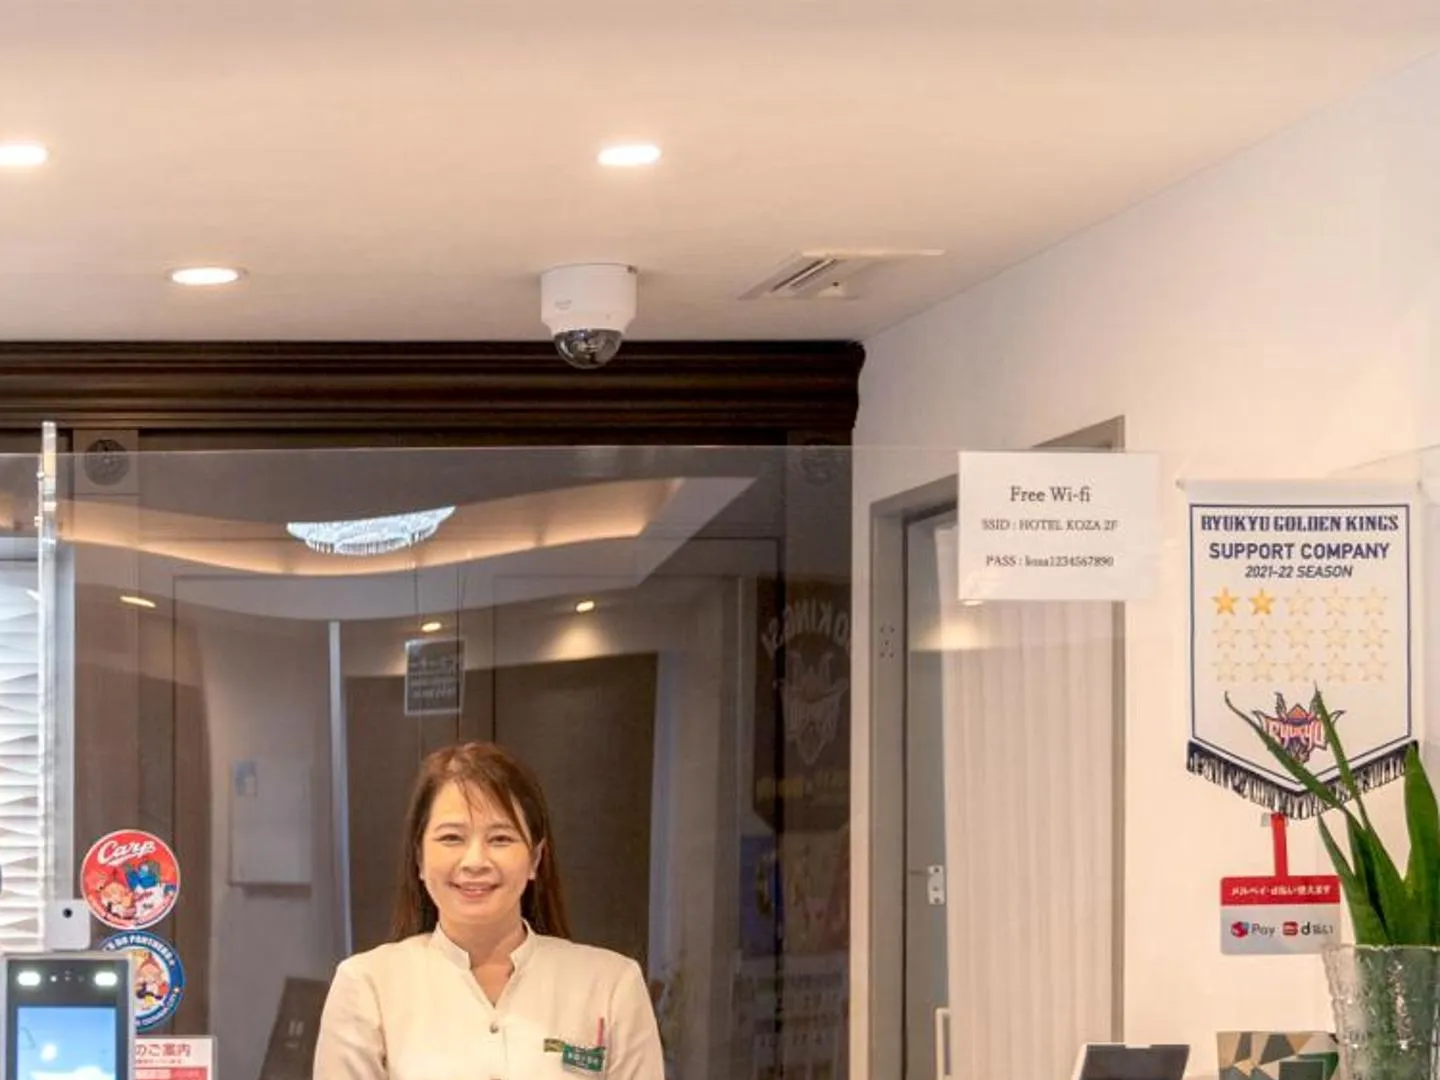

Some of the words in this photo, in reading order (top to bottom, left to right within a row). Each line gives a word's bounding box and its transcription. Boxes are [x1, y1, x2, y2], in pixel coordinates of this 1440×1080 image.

[1010, 485, 1046, 502] Free
[1050, 485, 1092, 504] Wi-fi
[982, 519, 1011, 531] SSID
[1019, 519, 1063, 531] HOTEL
[1066, 519, 1101, 531] KOZA
[1201, 515, 1270, 532] RYUKYU
[1273, 515, 1342, 532] GOLDEN
[1345, 515, 1399, 532] KINGS
[1208, 542, 1295, 560] SUPPORT
[1300, 542, 1390, 560] COMPANY
[986, 555, 1017, 567] PASS
[1244, 565, 1294, 579] 2021-22
[1296, 565, 1353, 579] SEASON
[97, 839, 157, 866] Carp
[1251, 922, 1276, 937] Pay
